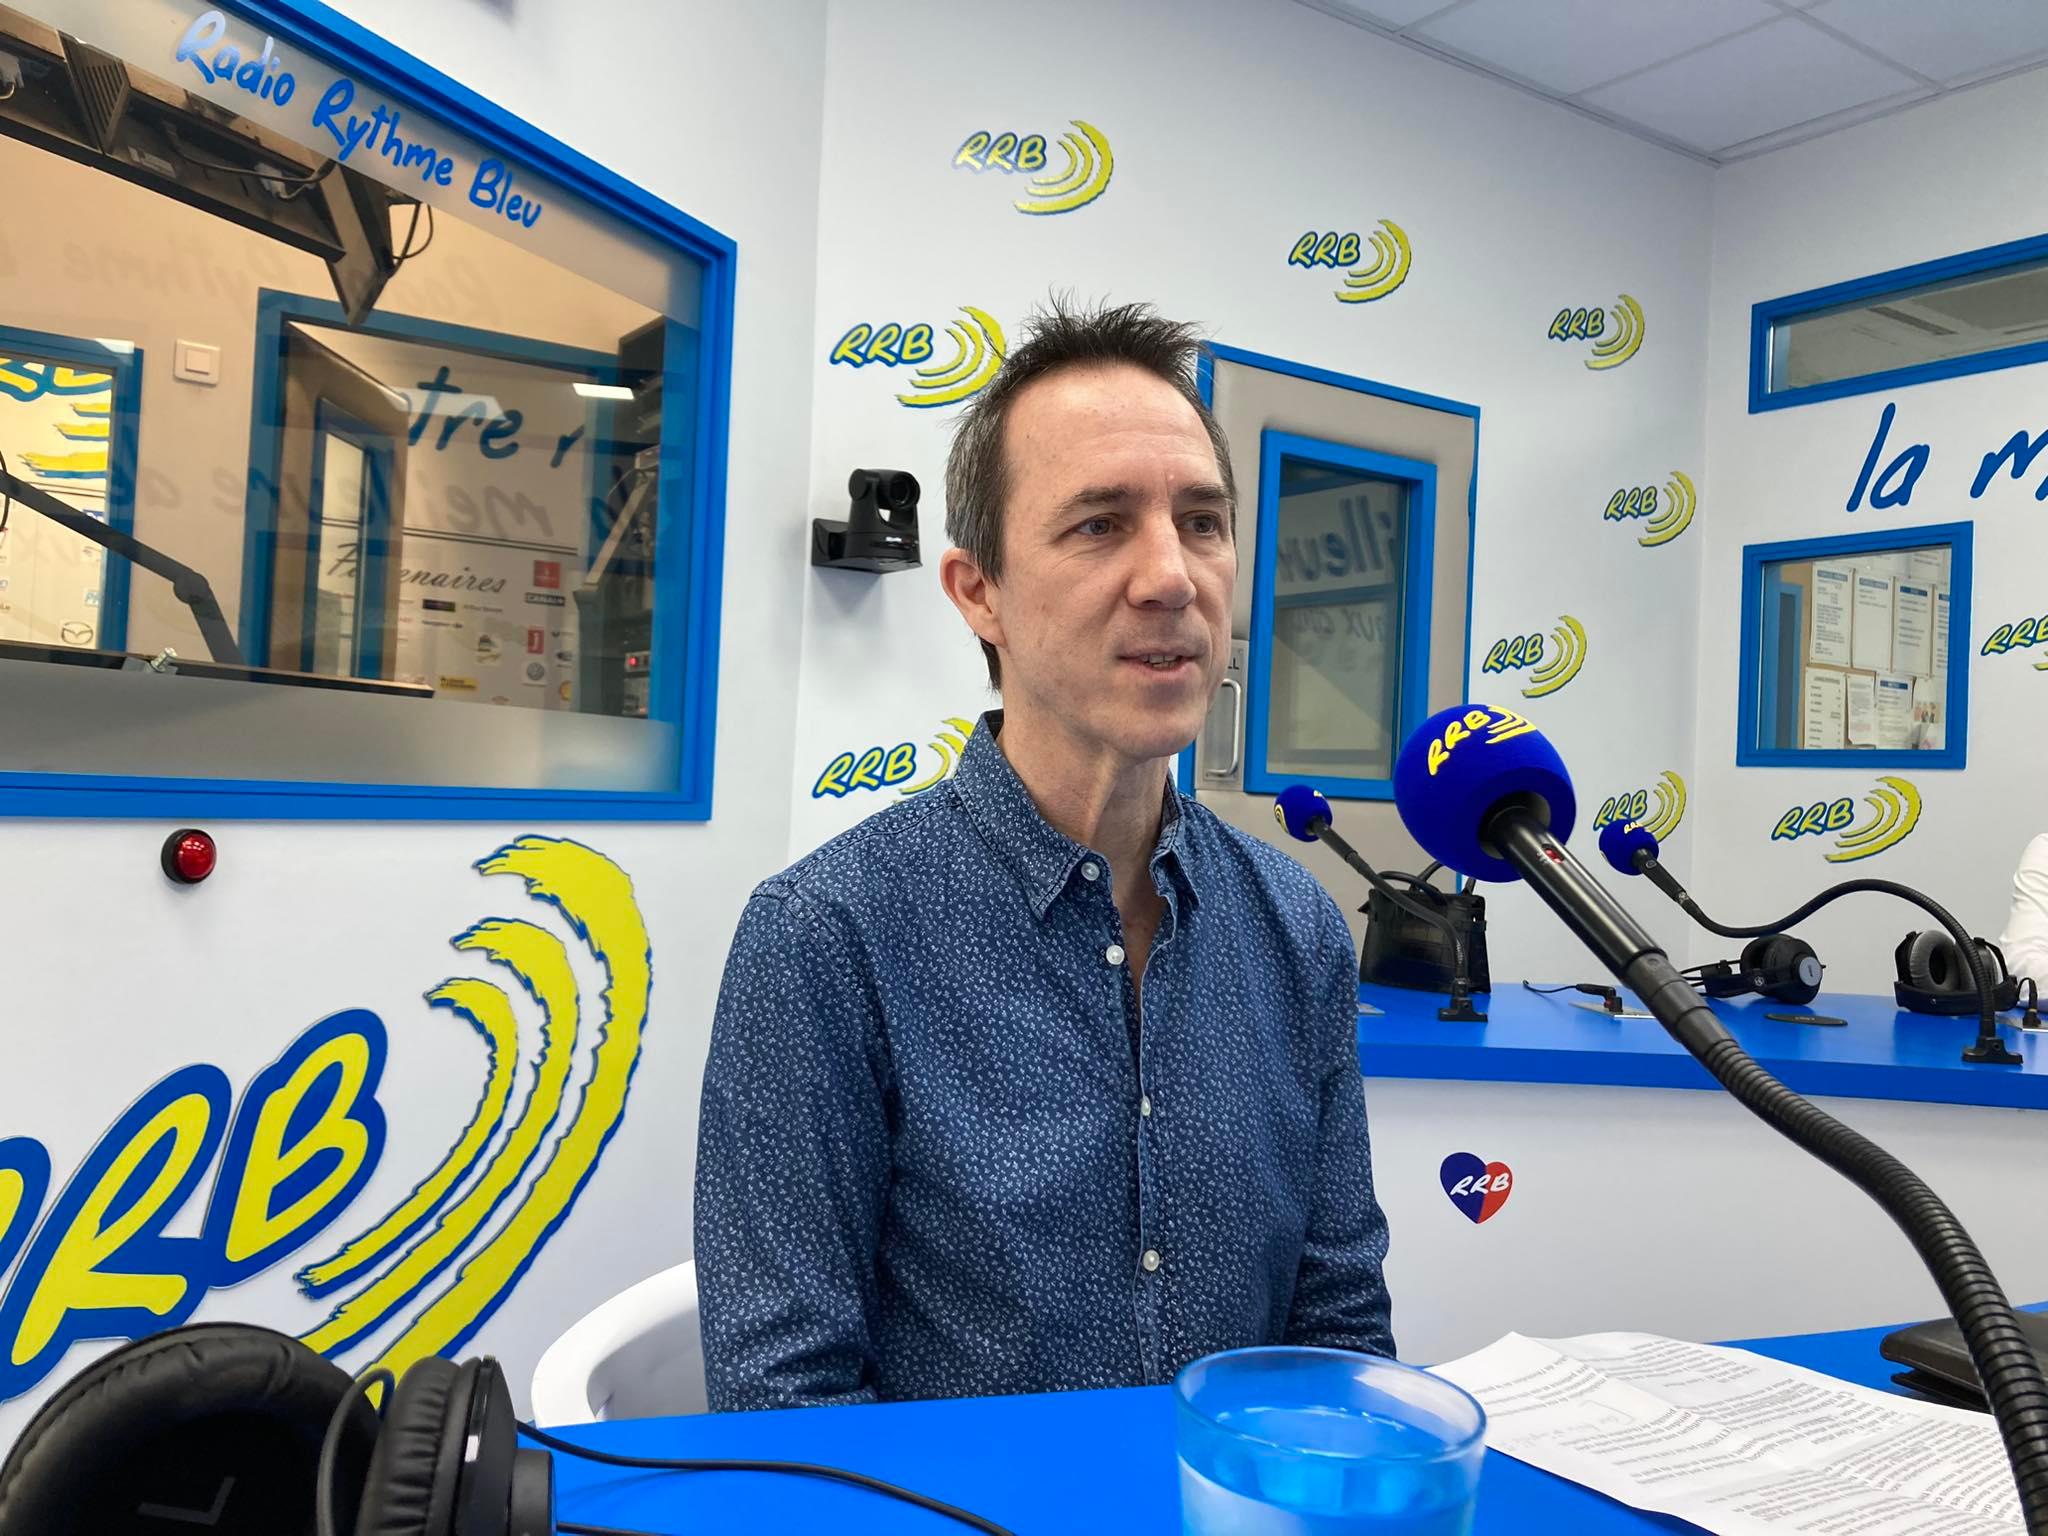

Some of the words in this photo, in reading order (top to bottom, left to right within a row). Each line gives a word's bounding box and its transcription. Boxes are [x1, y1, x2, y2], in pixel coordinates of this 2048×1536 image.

[175, 10, 296, 106] Radio
[312, 78, 455, 187] Rythme
[468, 158, 542, 229] Bleu
[953, 130, 1048, 175] RRB
[1288, 231, 1361, 269] RRB
[830, 322, 935, 369] RRB
[1547, 307, 1605, 342] RRB
[400, 366, 524, 460] tre
[1846, 402, 1930, 513] la
[1603, 486, 1658, 522] RRB
[1482, 633, 1545, 675] RRB
[1427, 710, 1492, 777] RRB
[812, 742, 917, 799] RRB
[1593, 789, 1648, 832] RRB
[1771, 795, 1855, 842] RRB
[0, 1008, 388, 1401] RB
[1449, 1172, 1510, 1197] RRB
